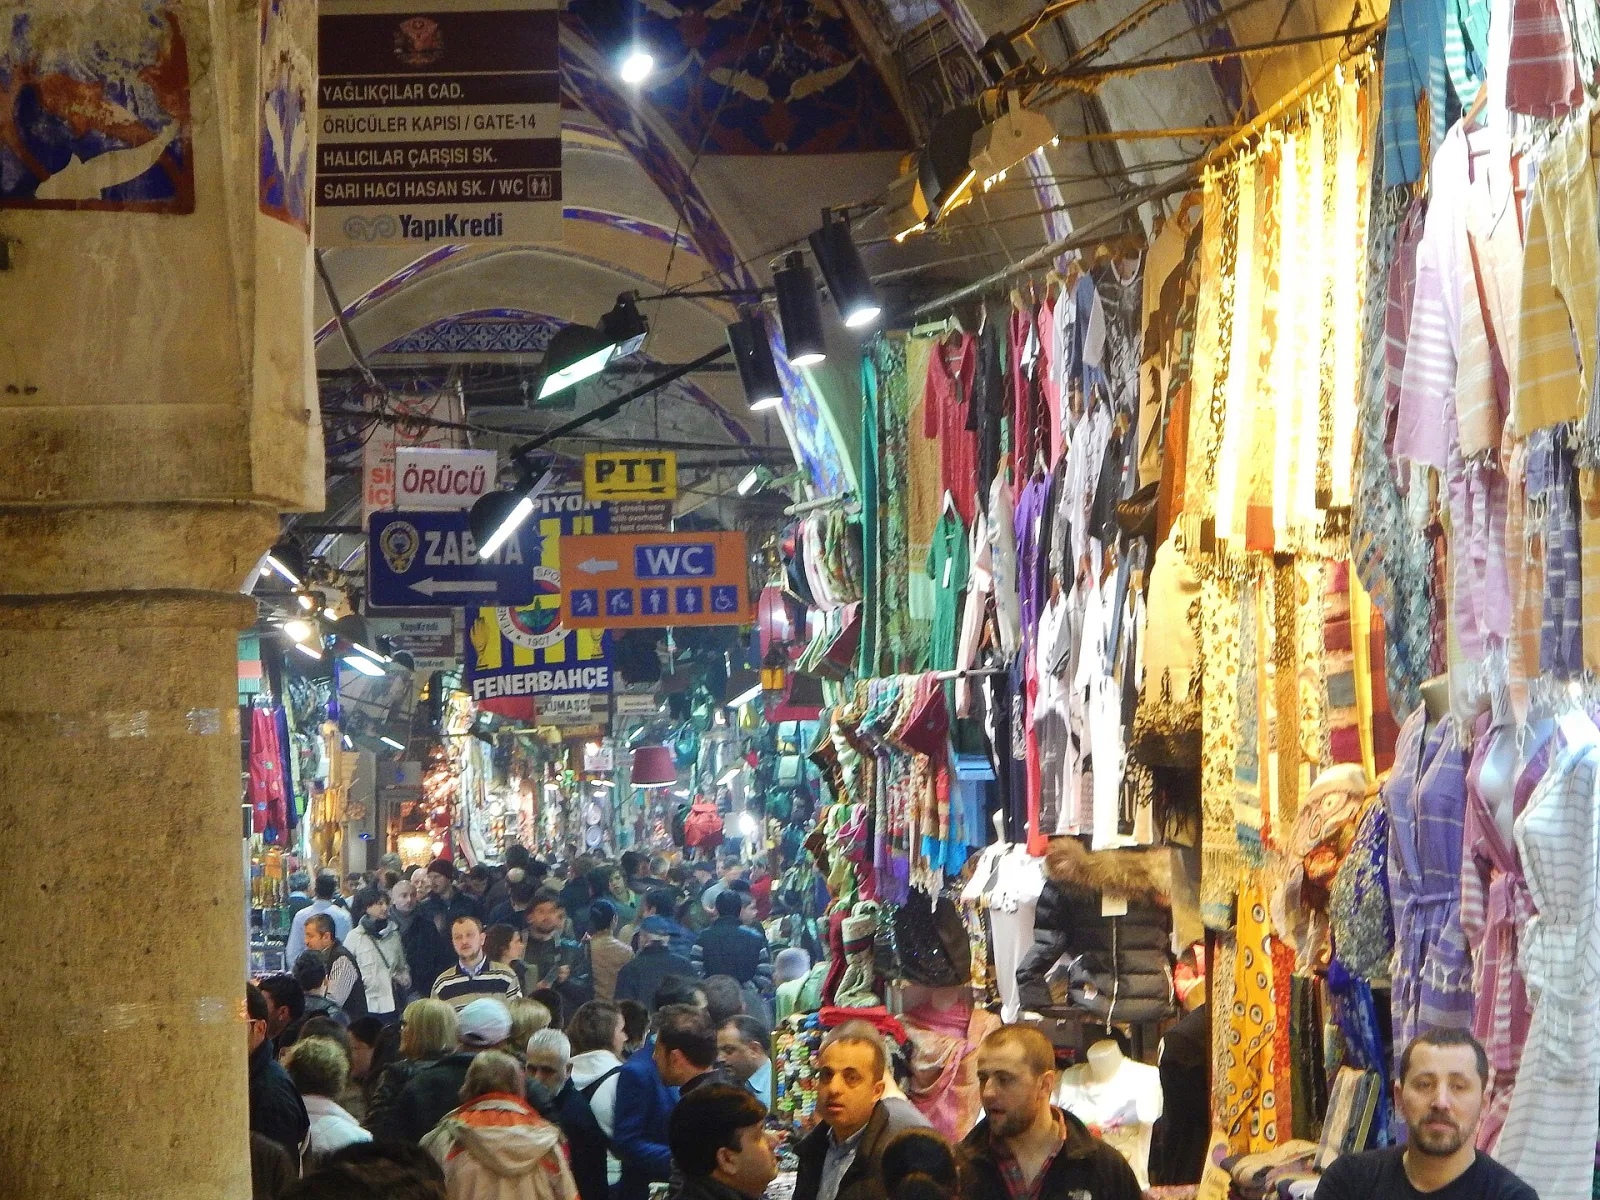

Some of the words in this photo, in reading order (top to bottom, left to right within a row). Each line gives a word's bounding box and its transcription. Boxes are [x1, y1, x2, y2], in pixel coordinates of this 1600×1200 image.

[323, 82, 424, 104] YAĞLIKÇILAR
[428, 83, 465, 99] CAD.
[323, 115, 407, 134] ÖRÜCÜLER
[412, 116, 461, 132] KAPISI
[474, 114, 536, 131] GATE-14
[324, 149, 404, 167] HALICILAR
[408, 147, 468, 168] ÇARŞISI
[473, 147, 498, 163] SK.
[324, 182, 360, 200] SARI
[364, 181, 401, 198] HACI
[405, 180, 458, 197] HASAN
[462, 179, 486, 196] SK.
[500, 178, 524, 196] WC
[403, 463, 486, 495] ÖRÜCÜ
[595, 458, 666, 483] PTT
[645, 547, 705, 575] WC
[535, 567, 560, 583] SPO
[528, 635, 550, 646] 1907
[473, 666, 609, 700] FENERBAHÇE
